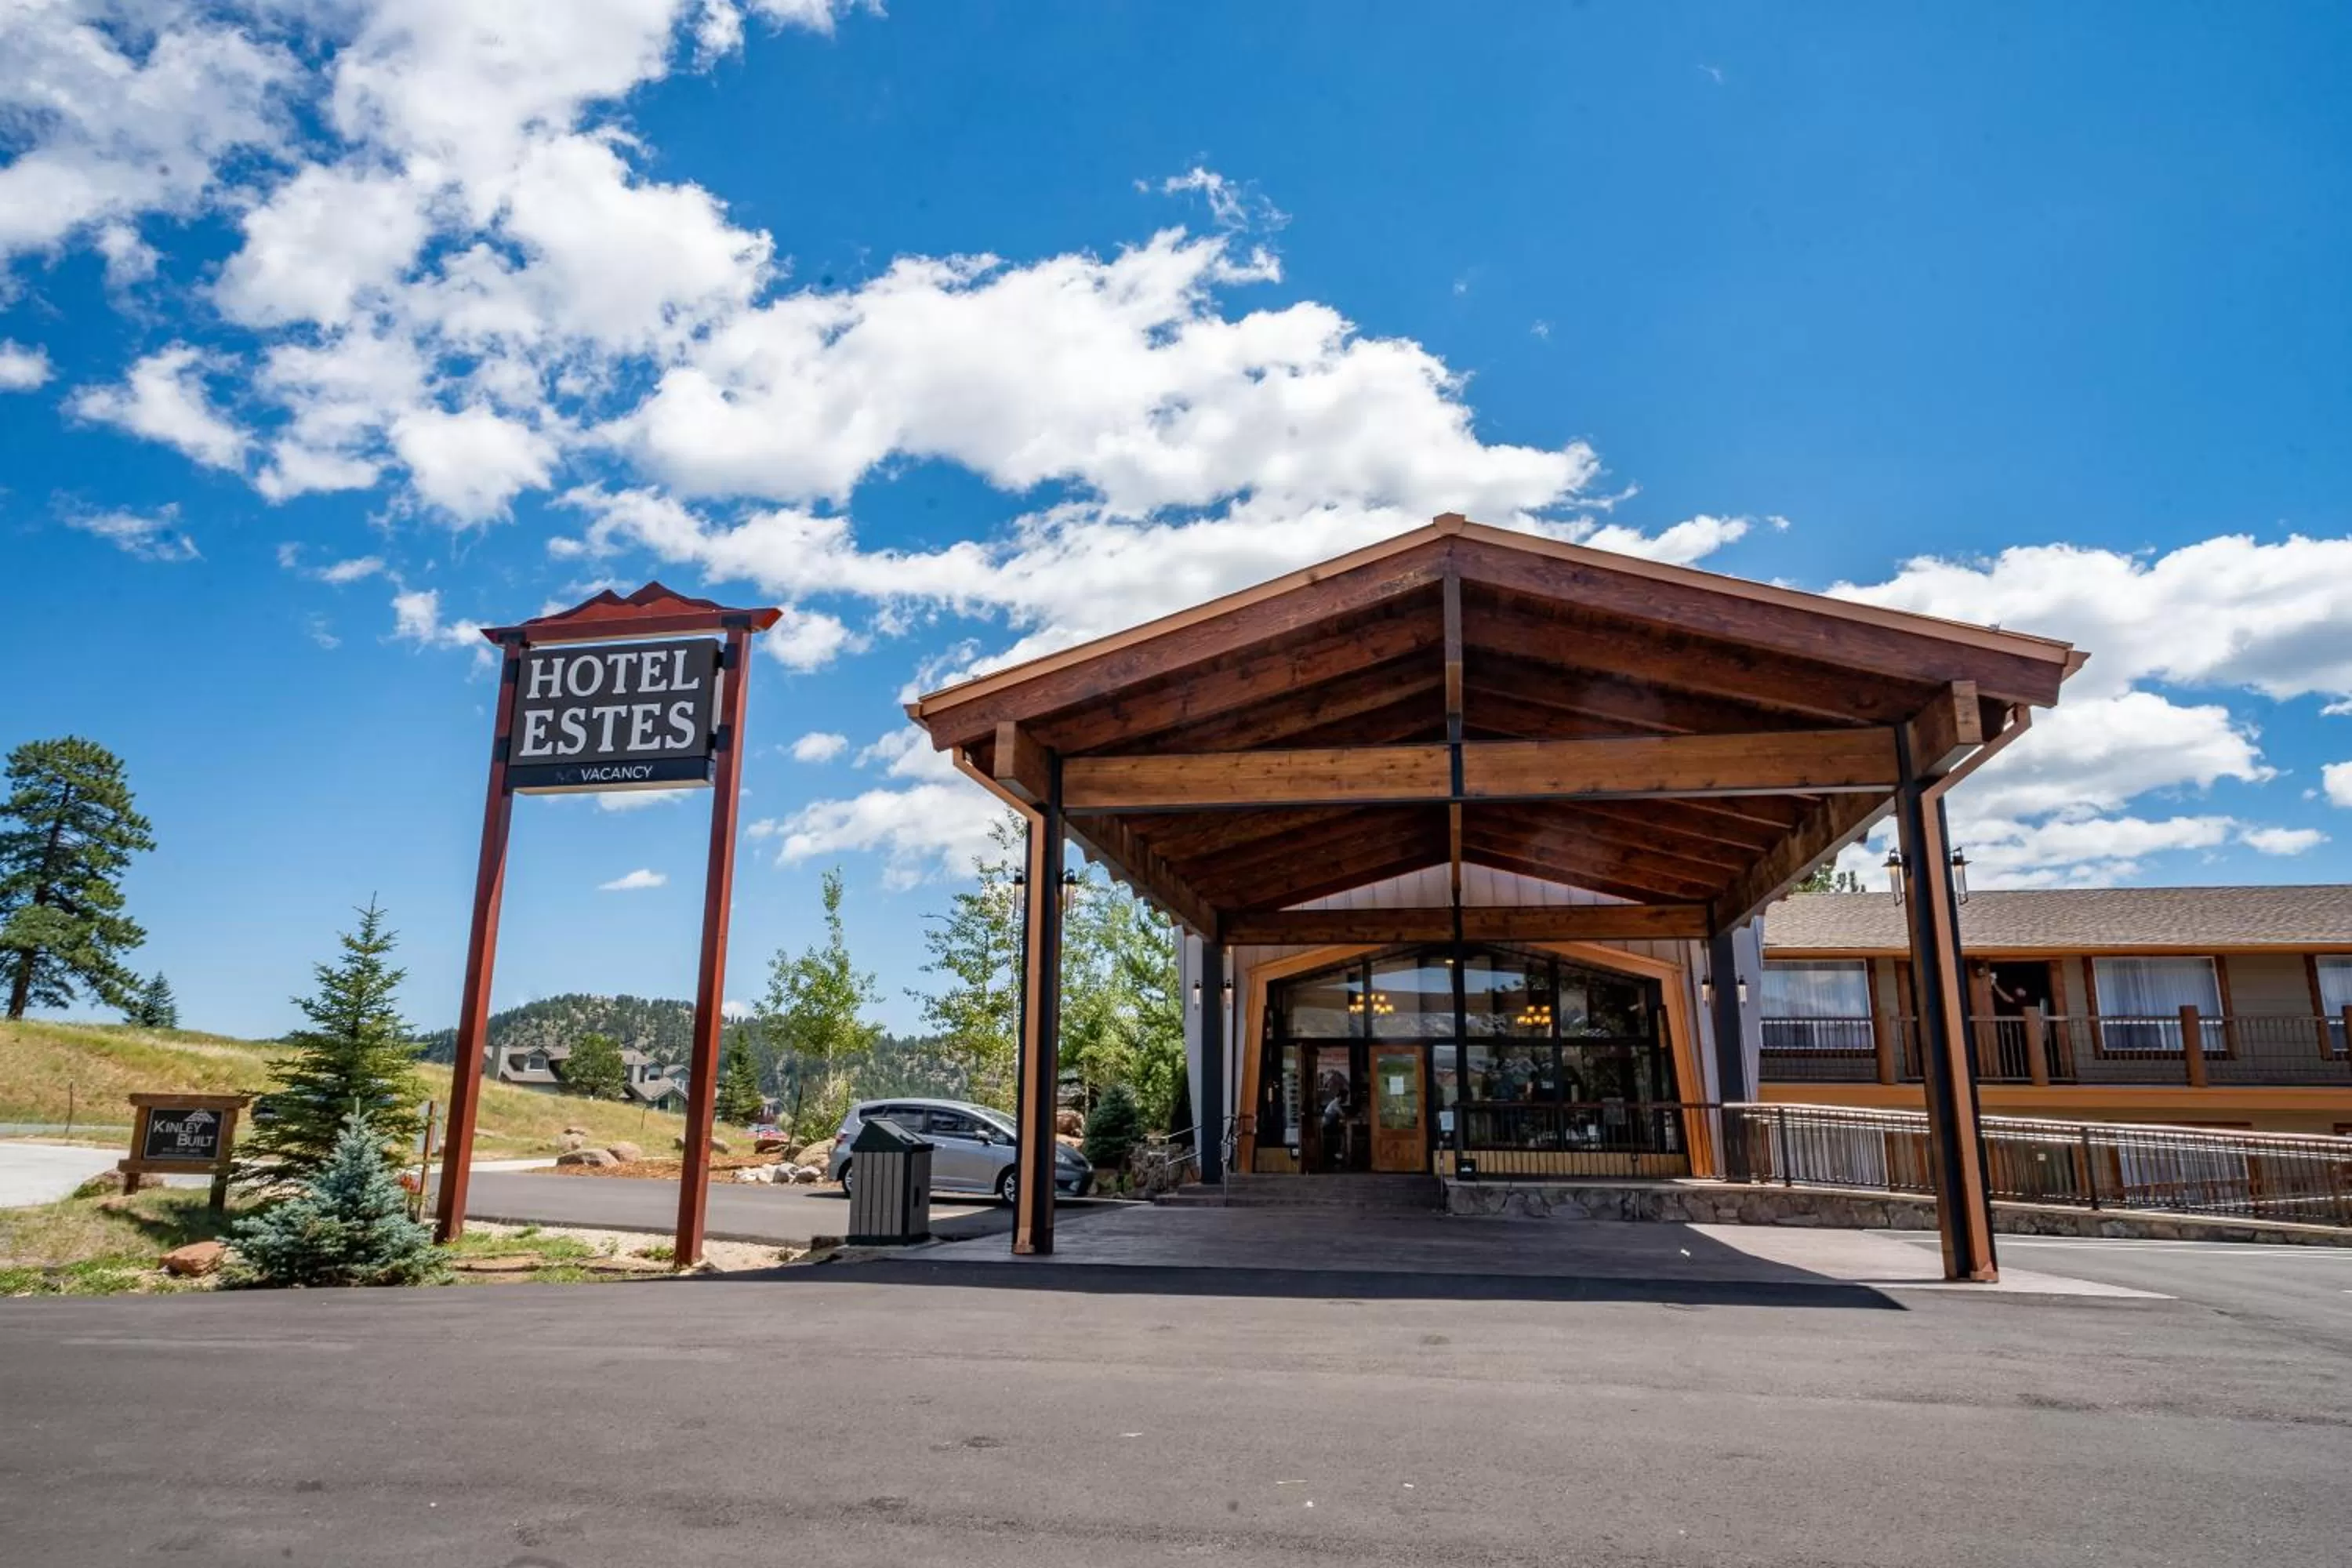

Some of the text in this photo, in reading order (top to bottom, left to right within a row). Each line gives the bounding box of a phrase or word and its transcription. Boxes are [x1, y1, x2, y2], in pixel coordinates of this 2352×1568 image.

[526, 649, 700, 699] HOTEL
[518, 701, 695, 757] ESTES
[581, 765, 653, 782] VACANCY
[153, 1120, 202, 1134] KINLEY
[176, 1134, 215, 1147] BUILT
